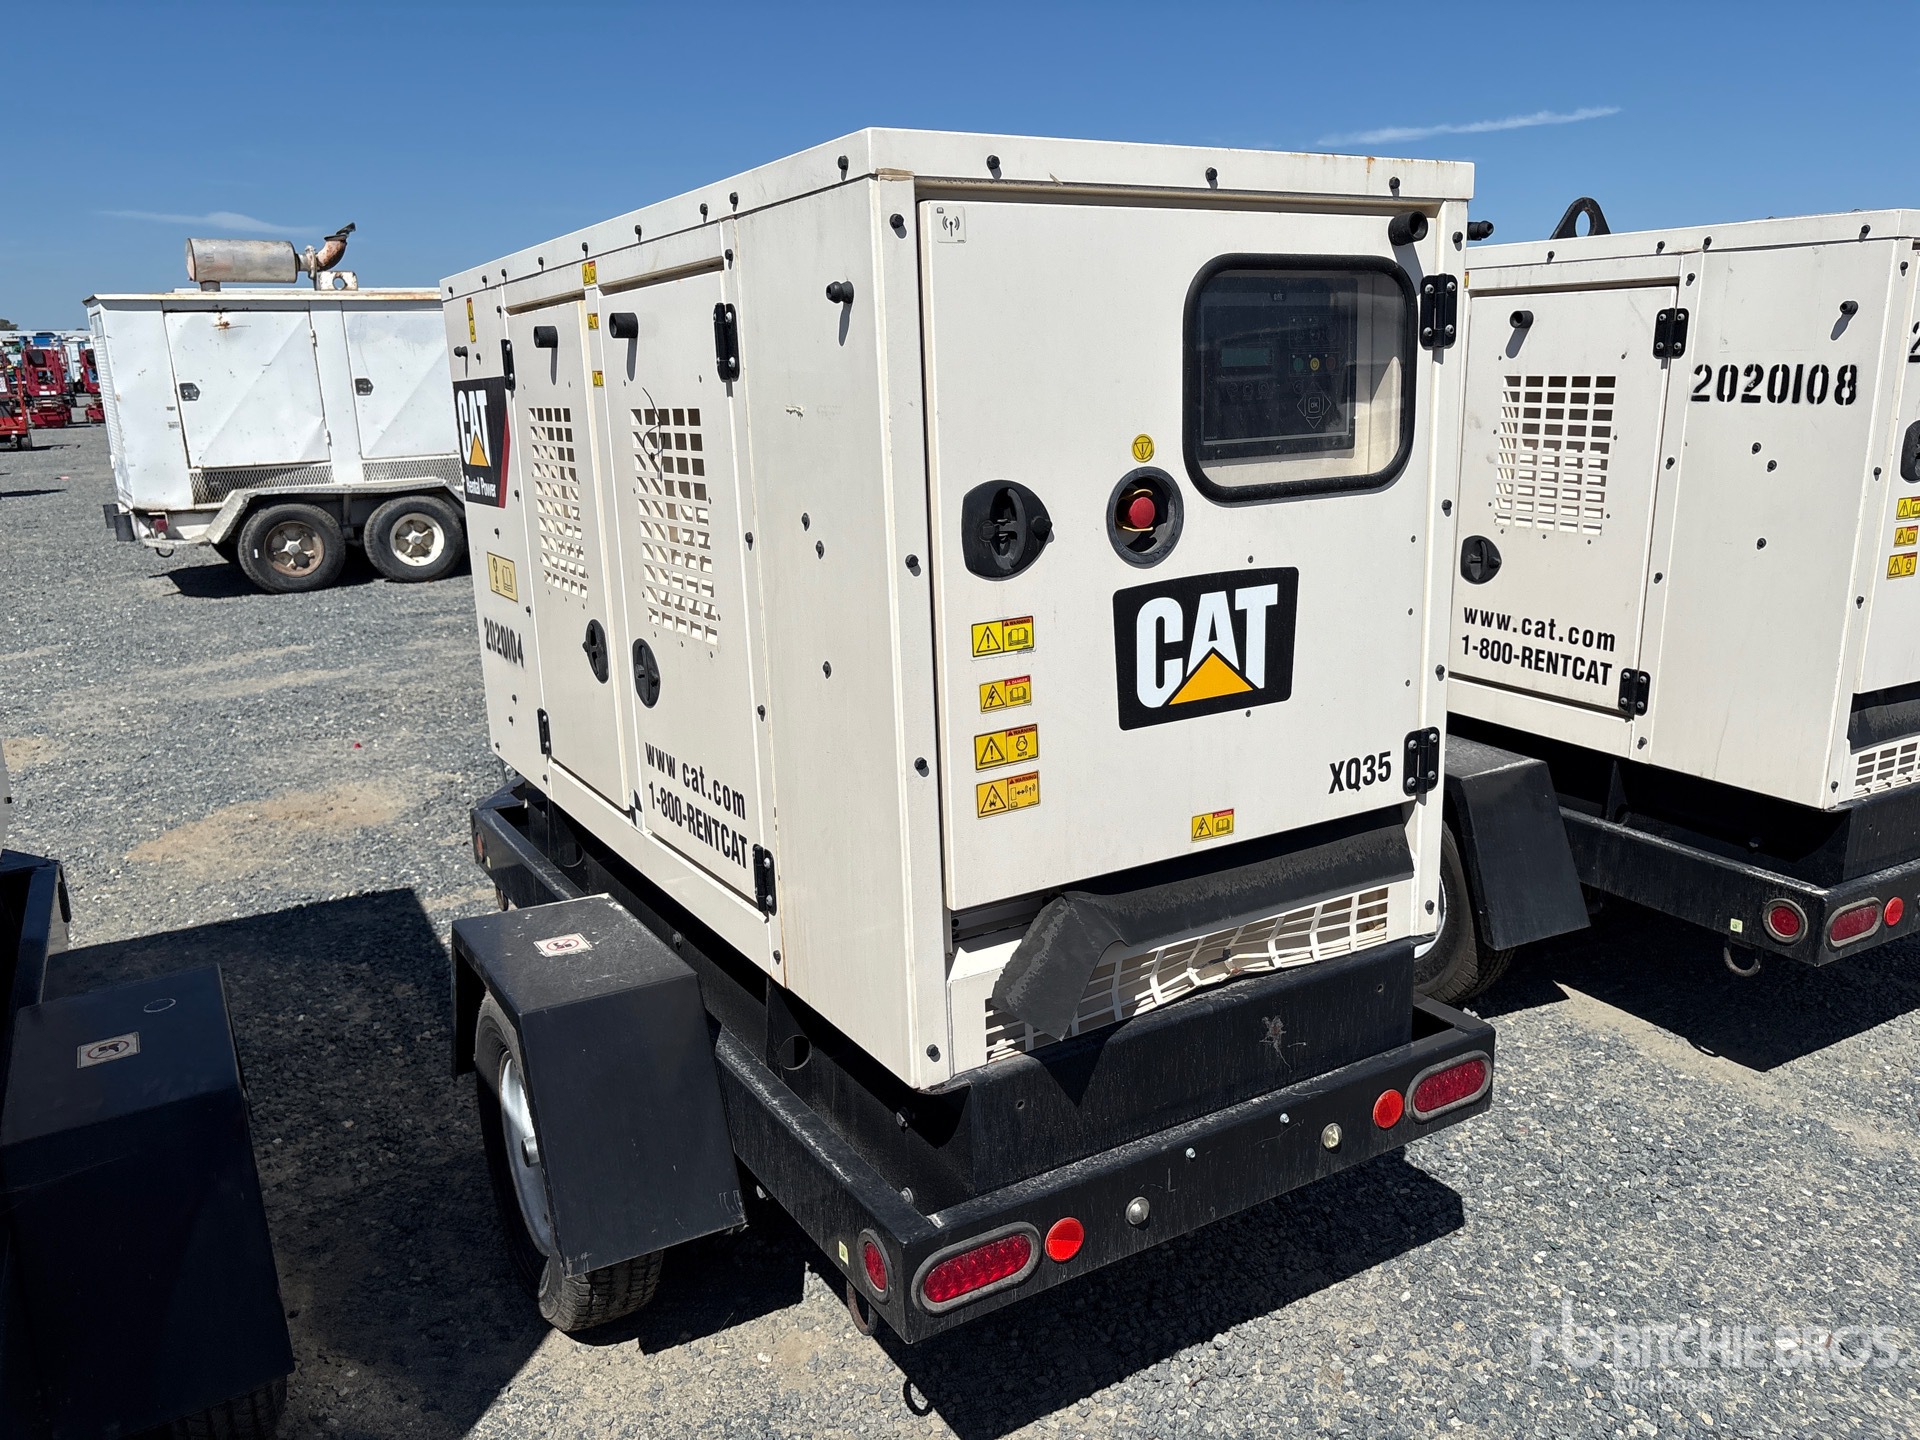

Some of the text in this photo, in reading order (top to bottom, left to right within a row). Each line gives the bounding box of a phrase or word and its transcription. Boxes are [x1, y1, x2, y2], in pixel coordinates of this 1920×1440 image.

[458, 390, 491, 467] CAT
[466, 475, 496, 498] Rental Power
[1136, 583, 1278, 709] CAT
[1463, 607, 1616, 652] www.cat.com
[1461, 635, 1613, 686] 1-800-RENTCAT
[1014, 727, 1036, 735] WARNING
[1015, 774, 1036, 783] WARNING
[1328, 751, 1392, 794] XQ35
[649, 781, 747, 869] 1-800-RENTCAT
